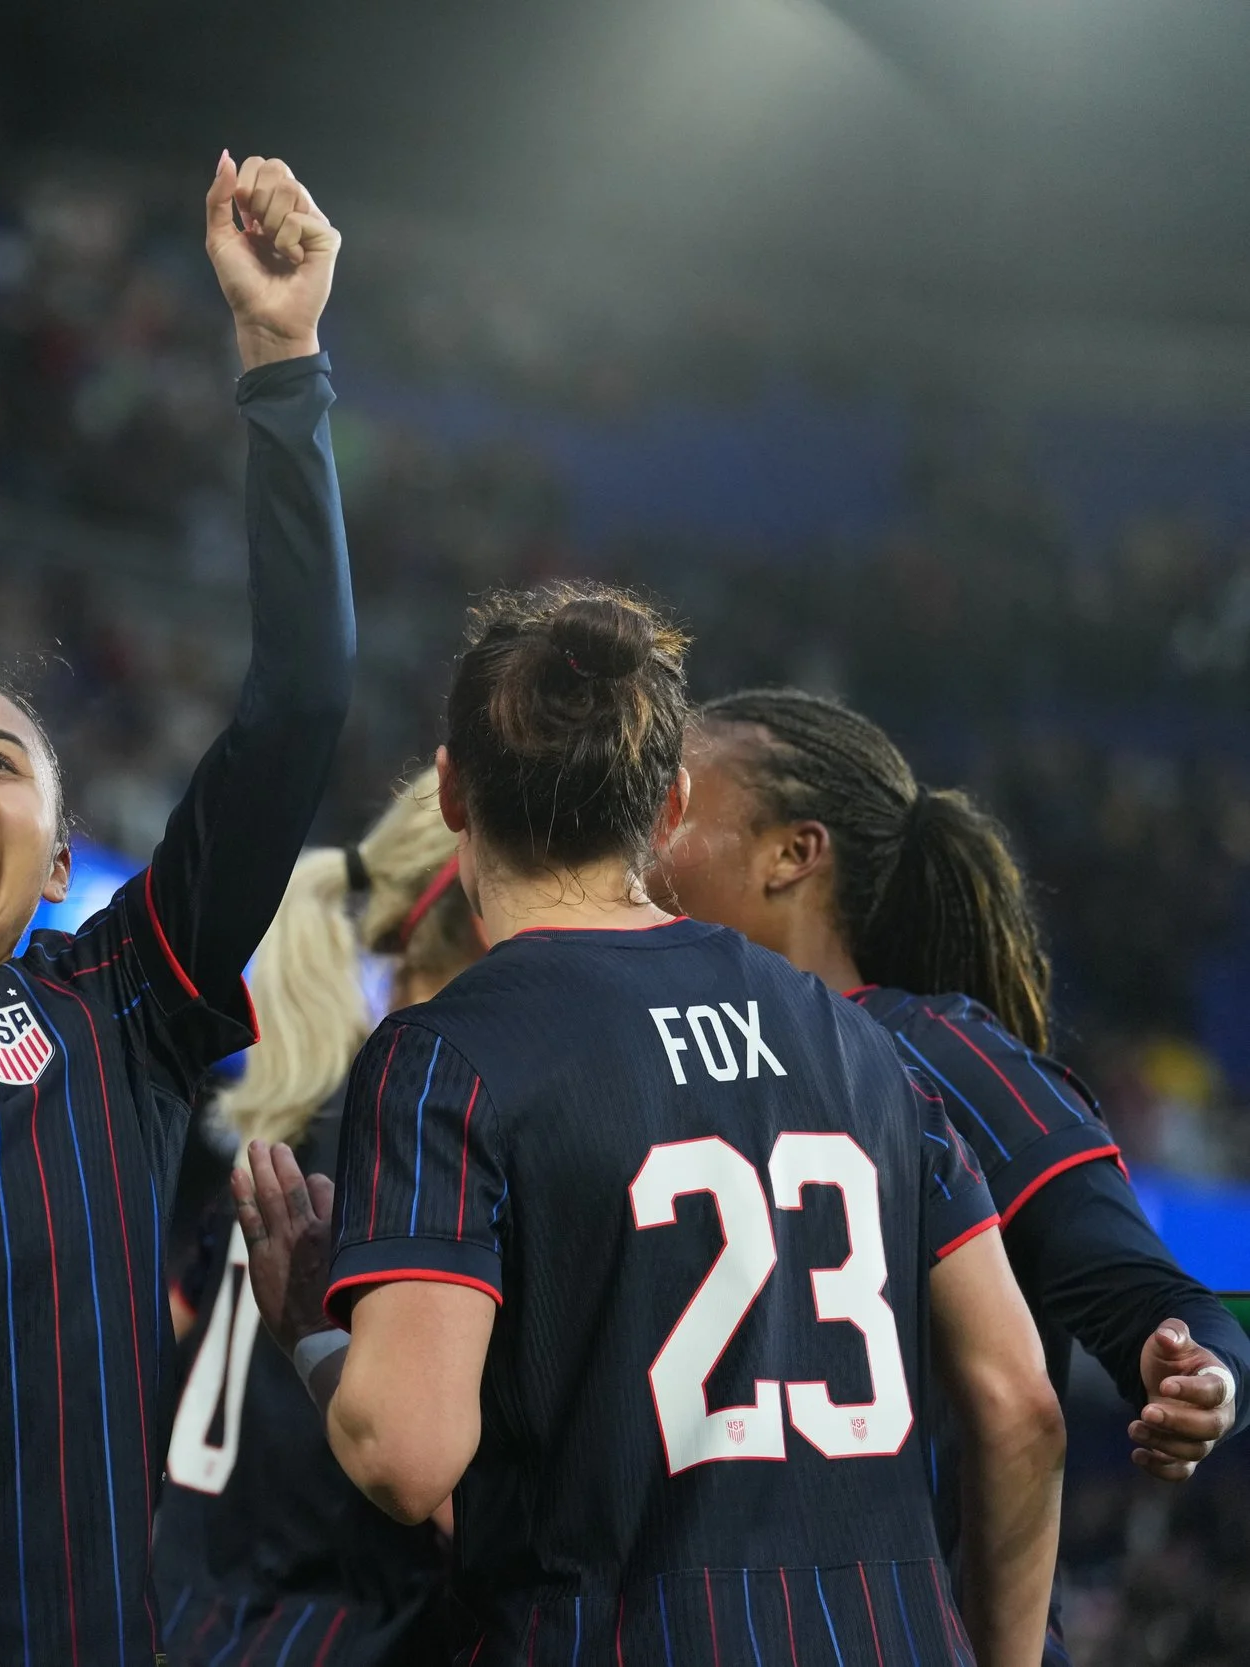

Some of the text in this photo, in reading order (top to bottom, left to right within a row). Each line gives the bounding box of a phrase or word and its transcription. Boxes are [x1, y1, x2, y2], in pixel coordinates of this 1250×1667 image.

[649, 1001, 787, 1085] FOX
[628, 1131, 914, 1477] 23
[727, 1421, 744, 1430] USA
[851, 1418, 865, 1428] USA
